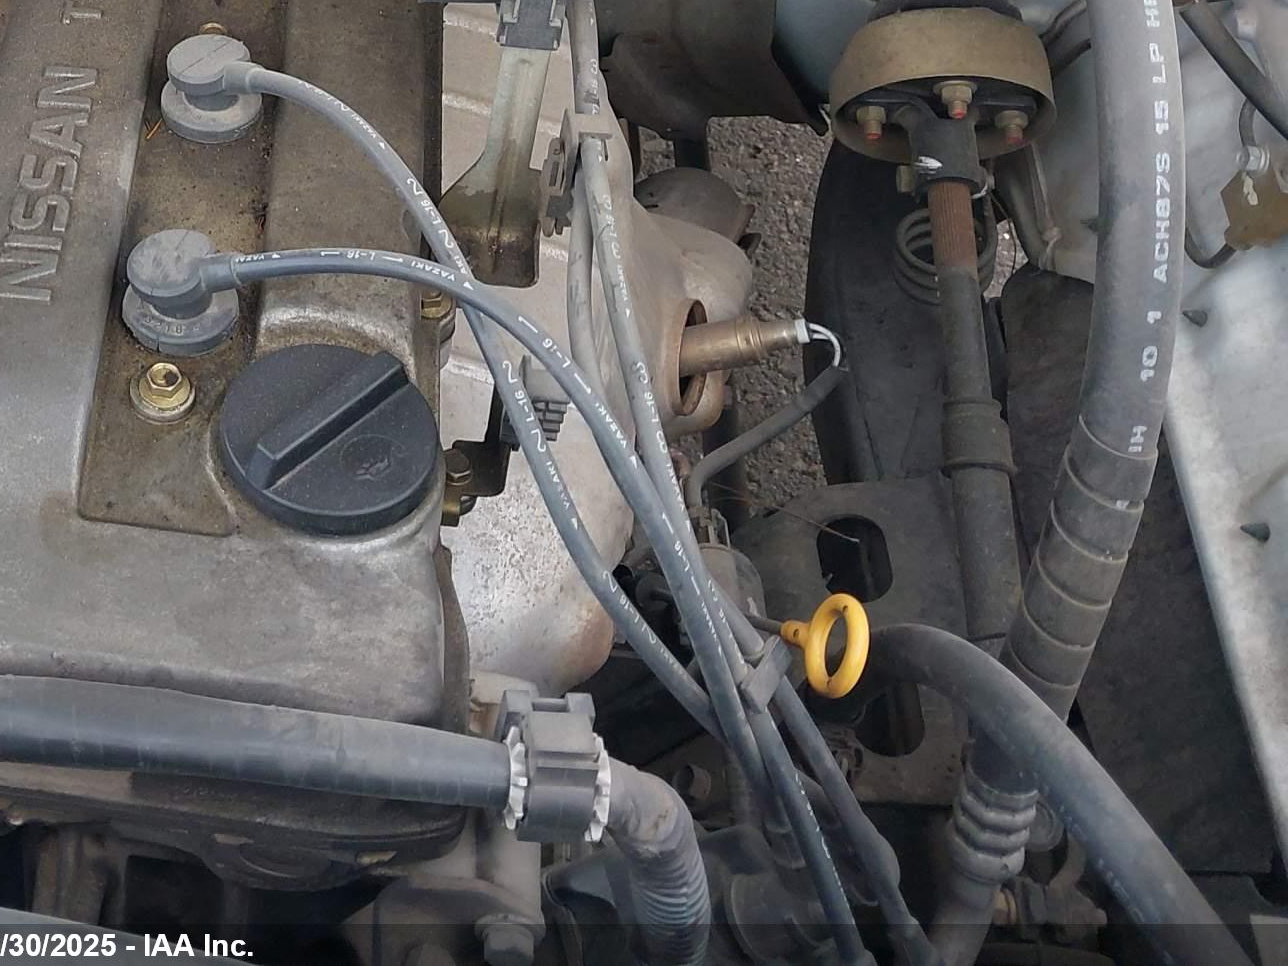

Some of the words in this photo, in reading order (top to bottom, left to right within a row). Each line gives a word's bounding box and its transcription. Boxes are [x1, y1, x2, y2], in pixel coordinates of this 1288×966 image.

[1148, 41, 1168, 85] LP
[1153, 99, 1171, 136] 15
[420, 199, 442, 226] L-16
[1152, 150, 1172, 284] ACH87S
[346, 251, 377, 261] L-16
[410, 260, 457, 283] YAZAKI
[541, 337, 572, 369] L-16
[1140, 345, 1159, 382] 10
[514, 389, 535, 424] L-16
[594, 401, 628, 450] YAZAKI
